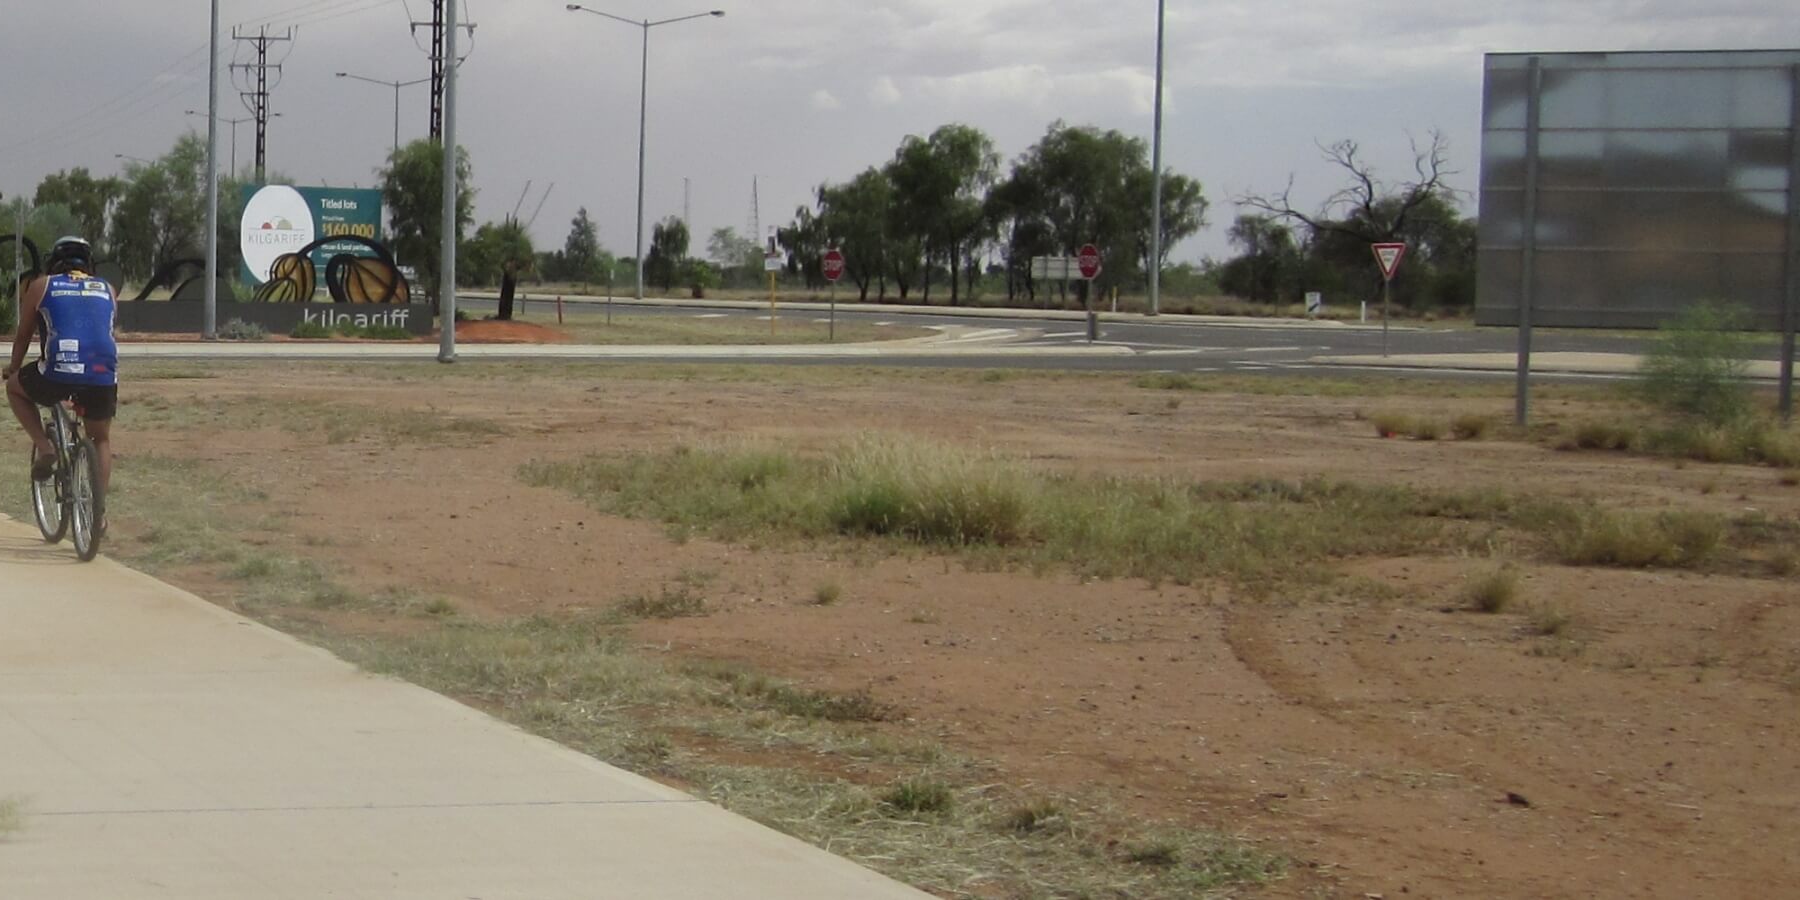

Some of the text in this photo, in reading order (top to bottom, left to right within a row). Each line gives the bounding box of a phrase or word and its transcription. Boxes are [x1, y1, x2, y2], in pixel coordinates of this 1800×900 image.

[343, 199, 358, 209] lots
[248, 233, 305, 244] KILGARIFF
[824, 260, 842, 270] STOP
[1080, 255, 1097, 268] STOP
